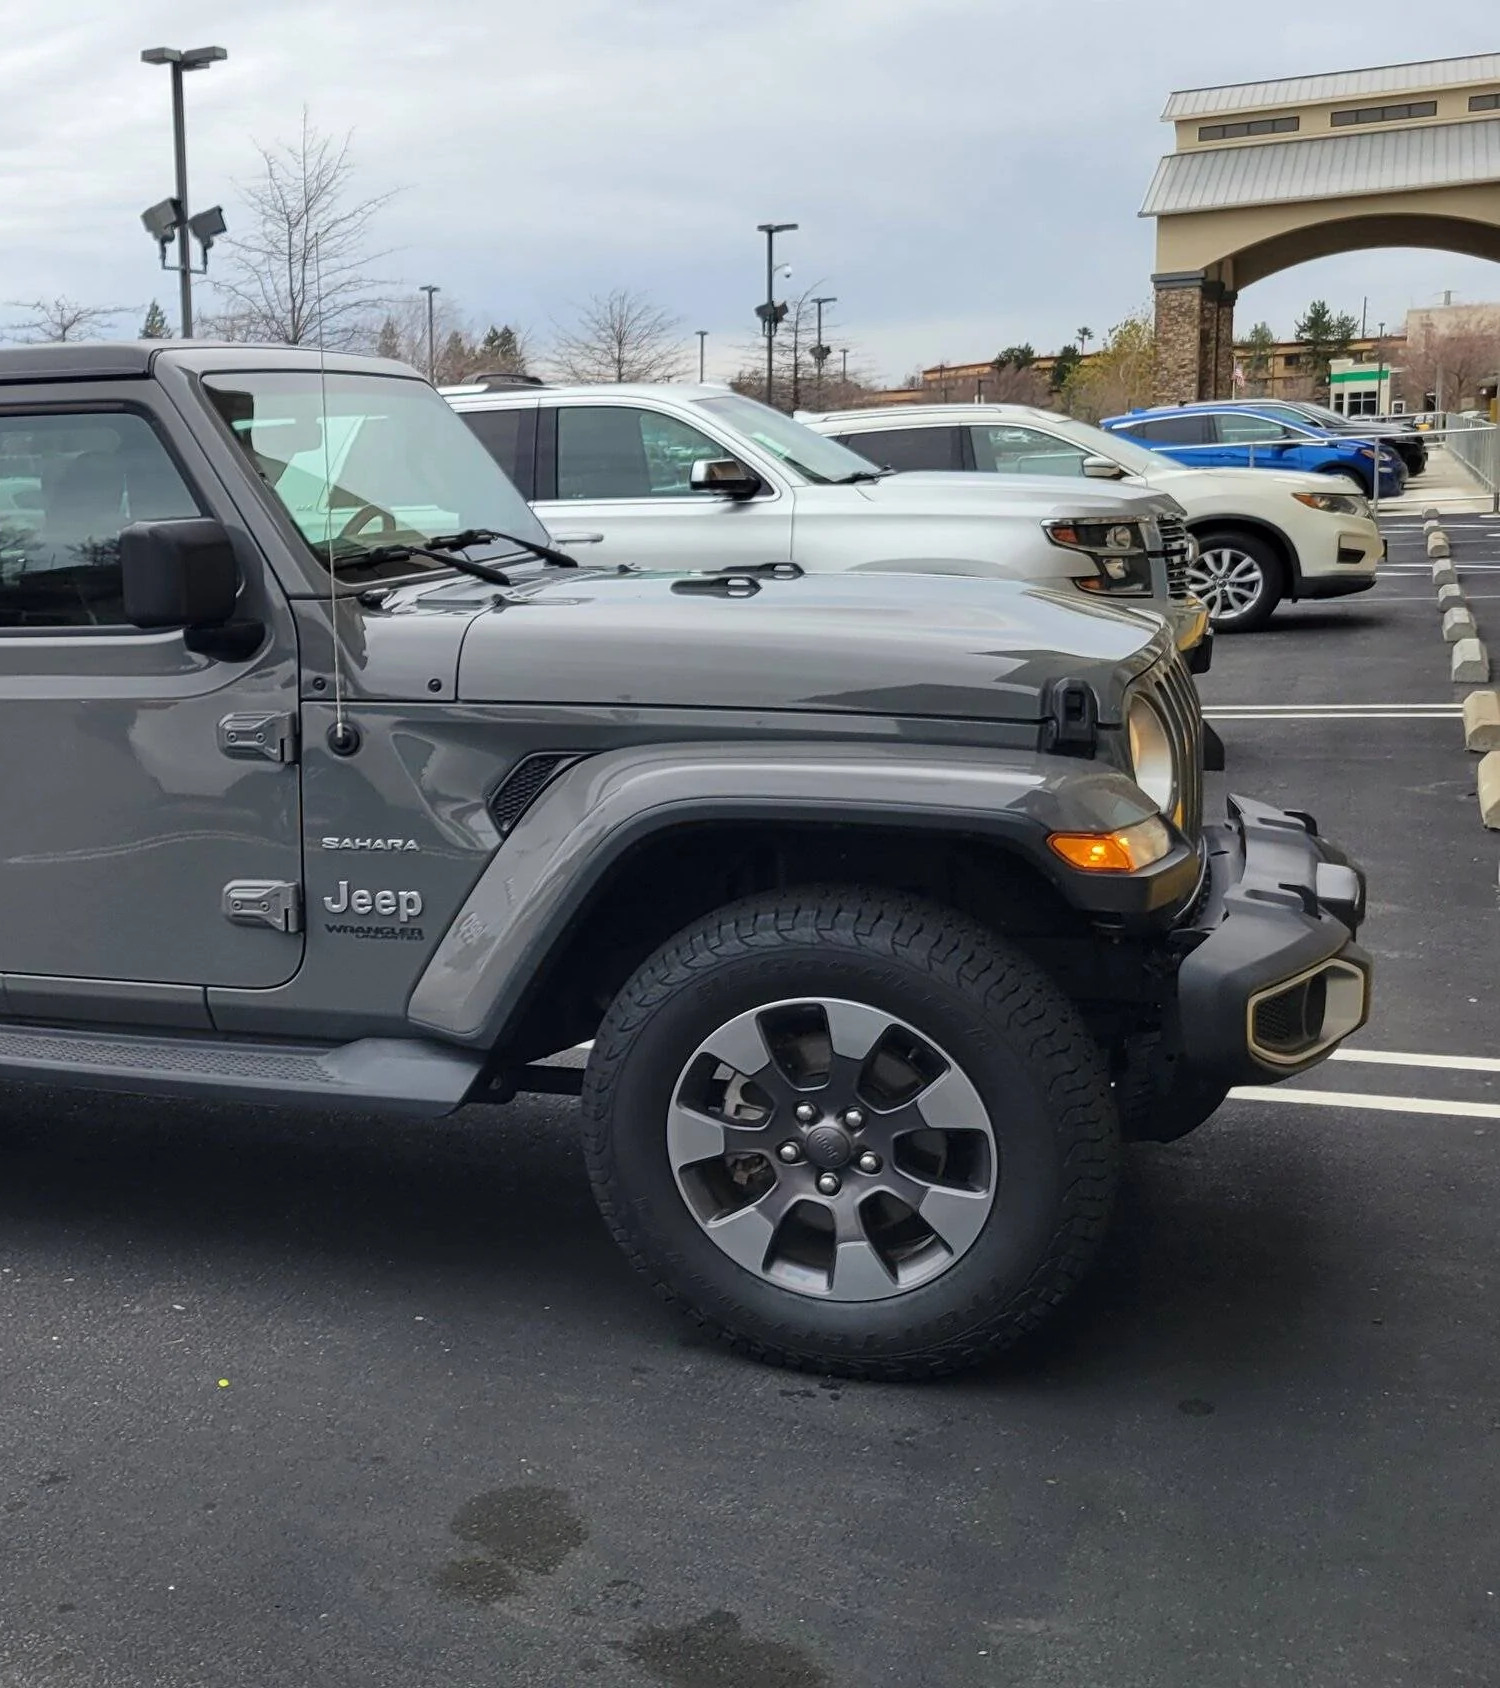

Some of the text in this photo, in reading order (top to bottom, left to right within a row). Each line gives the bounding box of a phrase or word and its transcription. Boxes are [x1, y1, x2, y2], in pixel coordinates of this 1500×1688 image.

[322, 837, 420, 851] SAHARA
[323, 881, 423, 922] Jeep
[325, 923, 423, 936] WRANGLER
